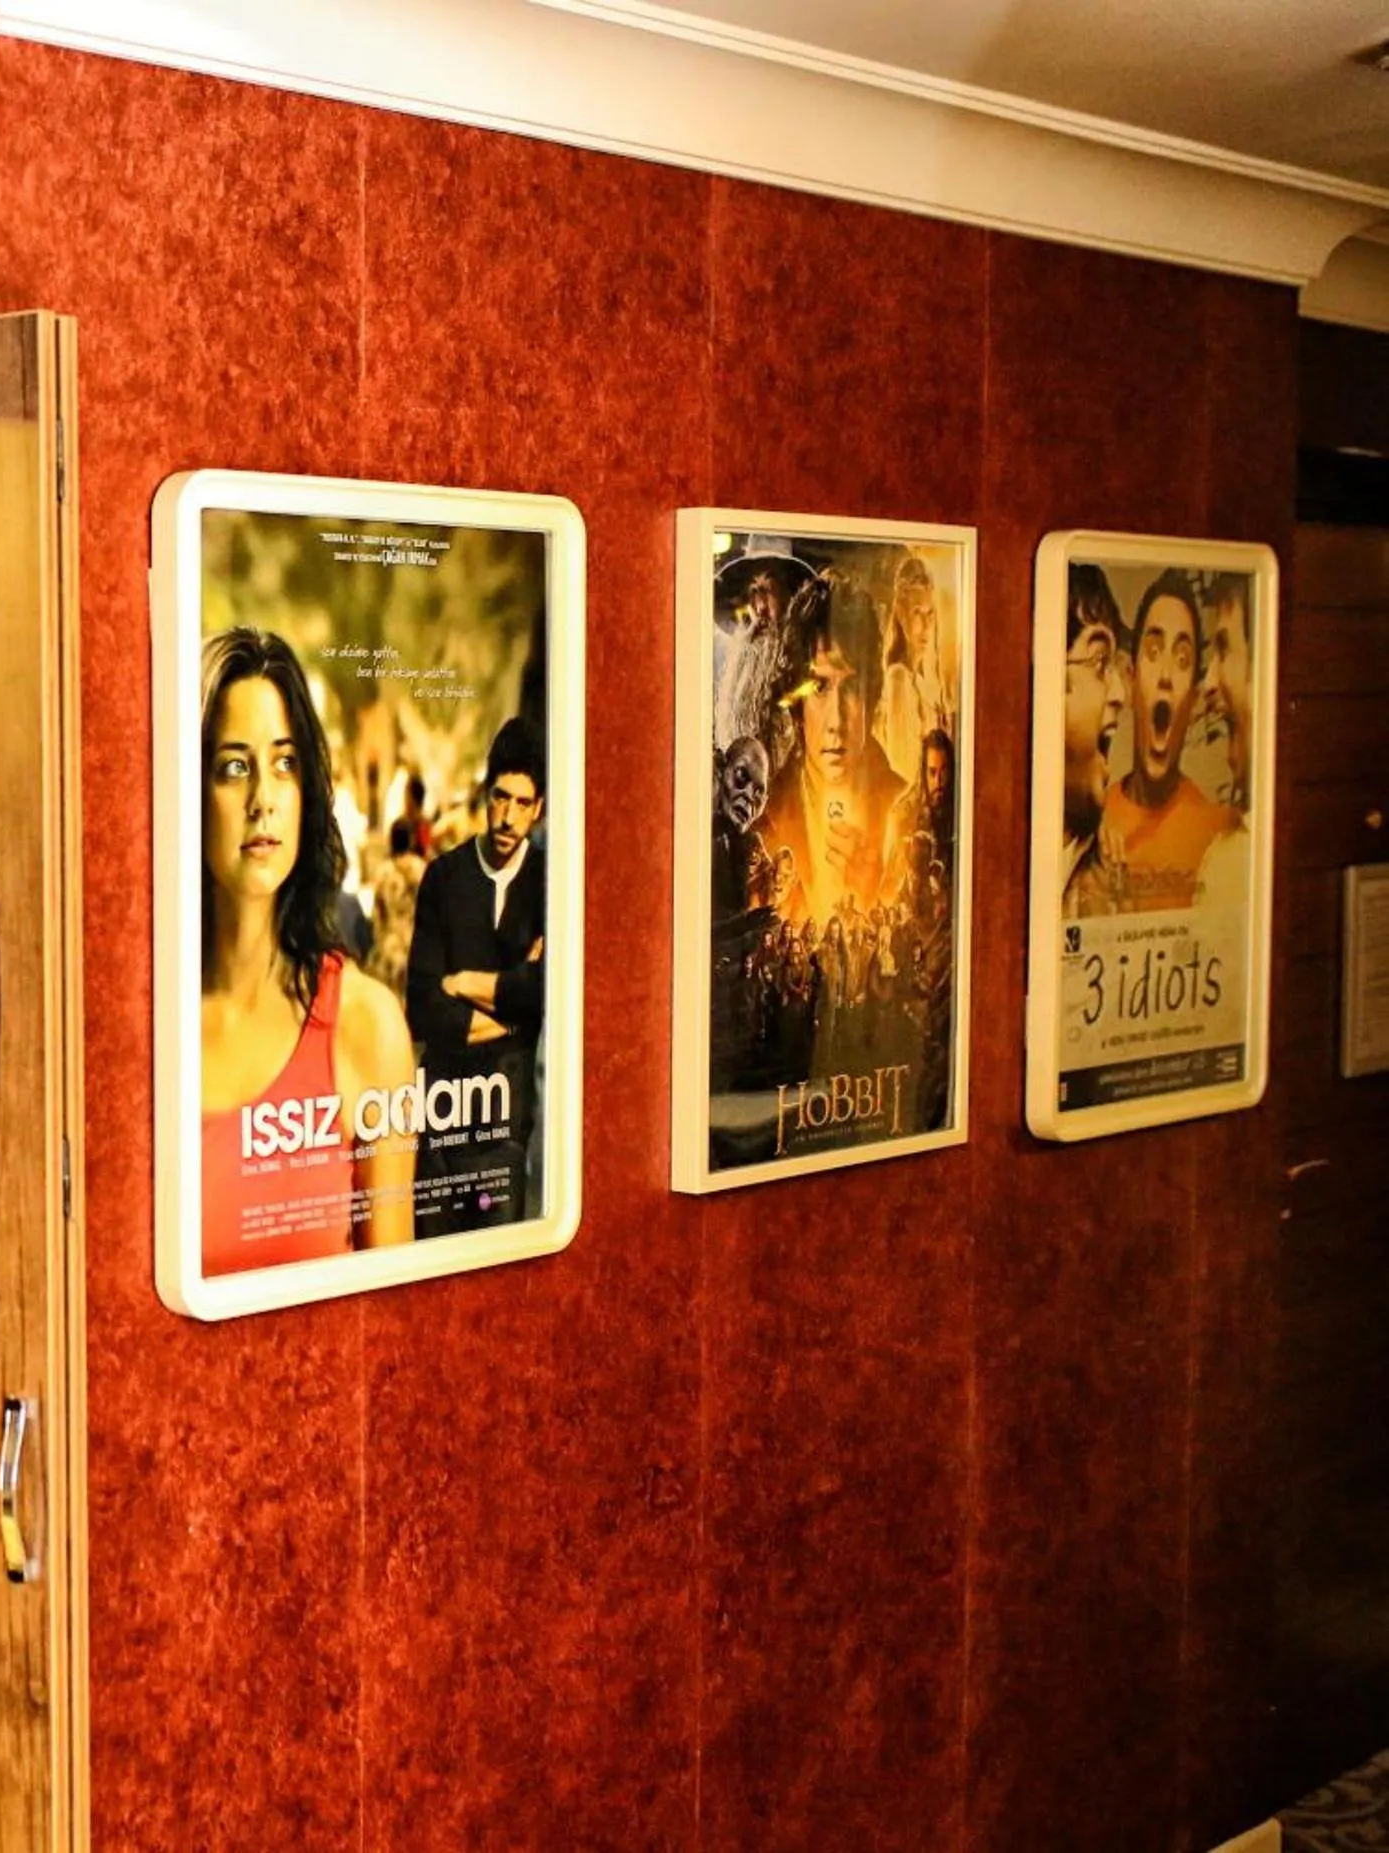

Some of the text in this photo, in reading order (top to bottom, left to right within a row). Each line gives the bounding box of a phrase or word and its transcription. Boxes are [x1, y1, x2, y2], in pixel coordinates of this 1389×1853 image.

[1083, 941, 1222, 1025] 3 idiots
[241, 1067, 511, 1159] ISSIZ adam
